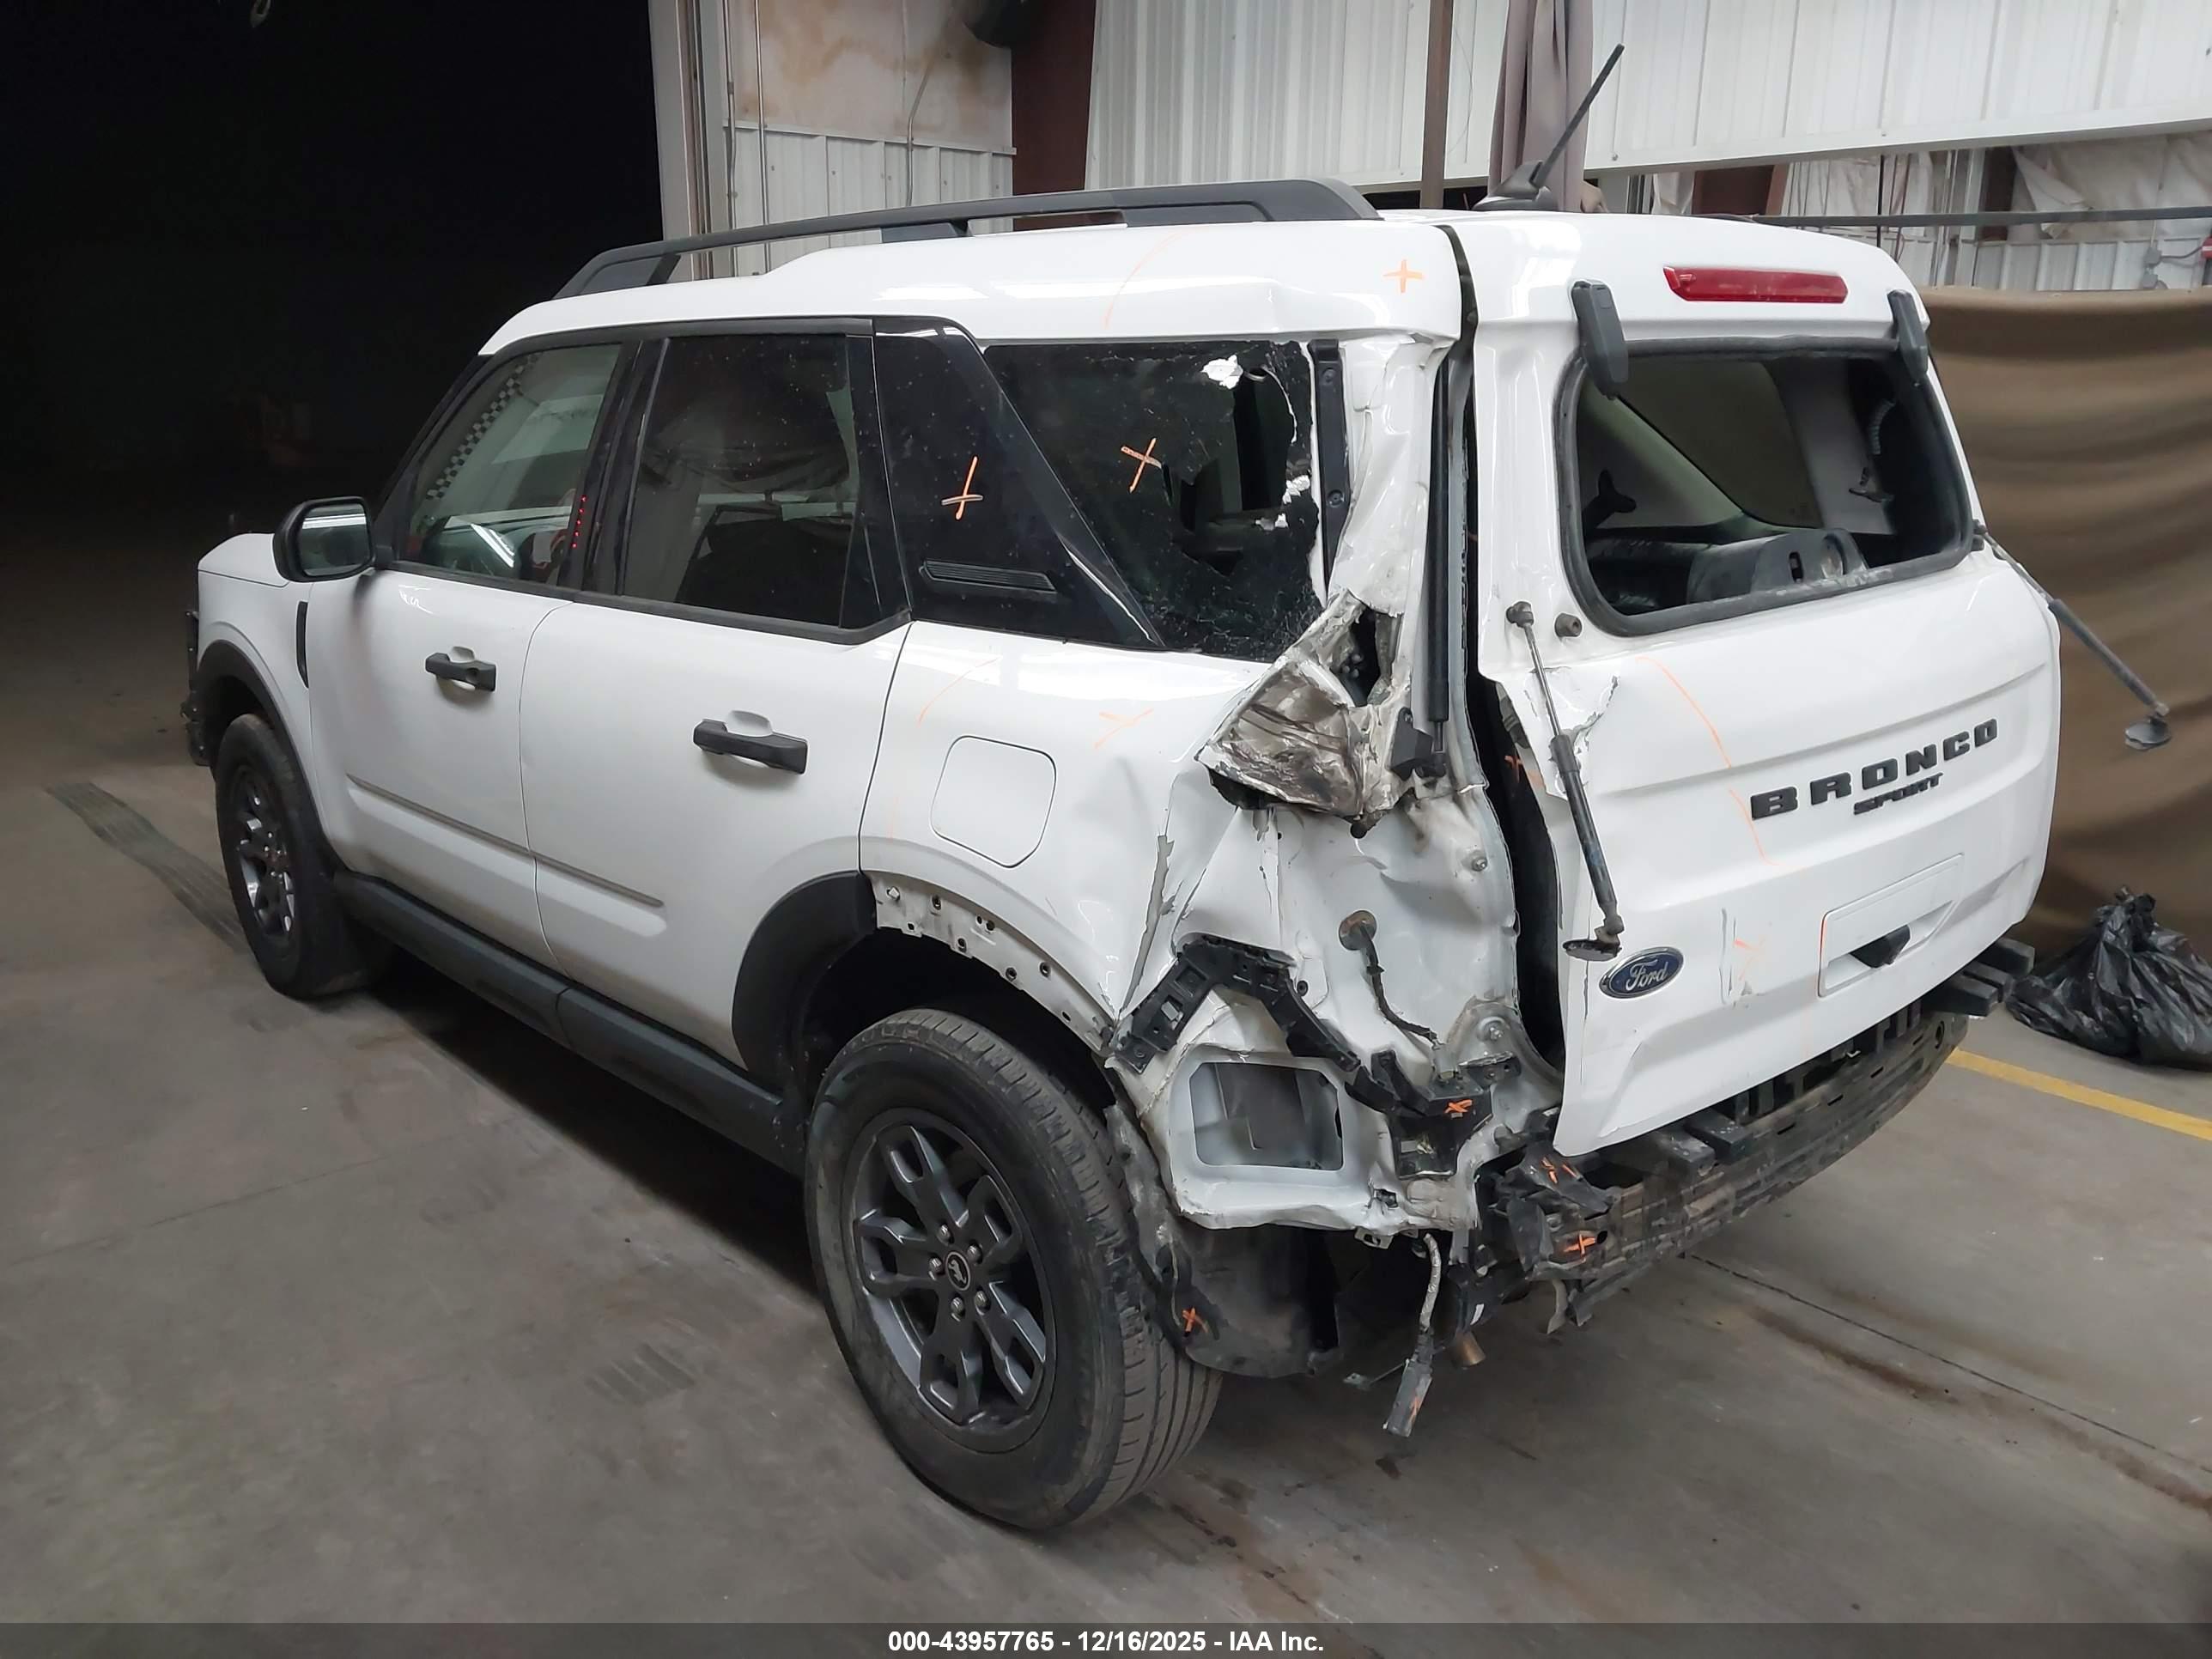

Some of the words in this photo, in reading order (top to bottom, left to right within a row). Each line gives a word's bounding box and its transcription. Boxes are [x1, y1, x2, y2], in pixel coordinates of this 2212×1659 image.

[1750, 718, 1999, 821] BRONCO
[1853, 771, 1944, 816] SPORT
[1625, 958, 1669, 991] Ford
